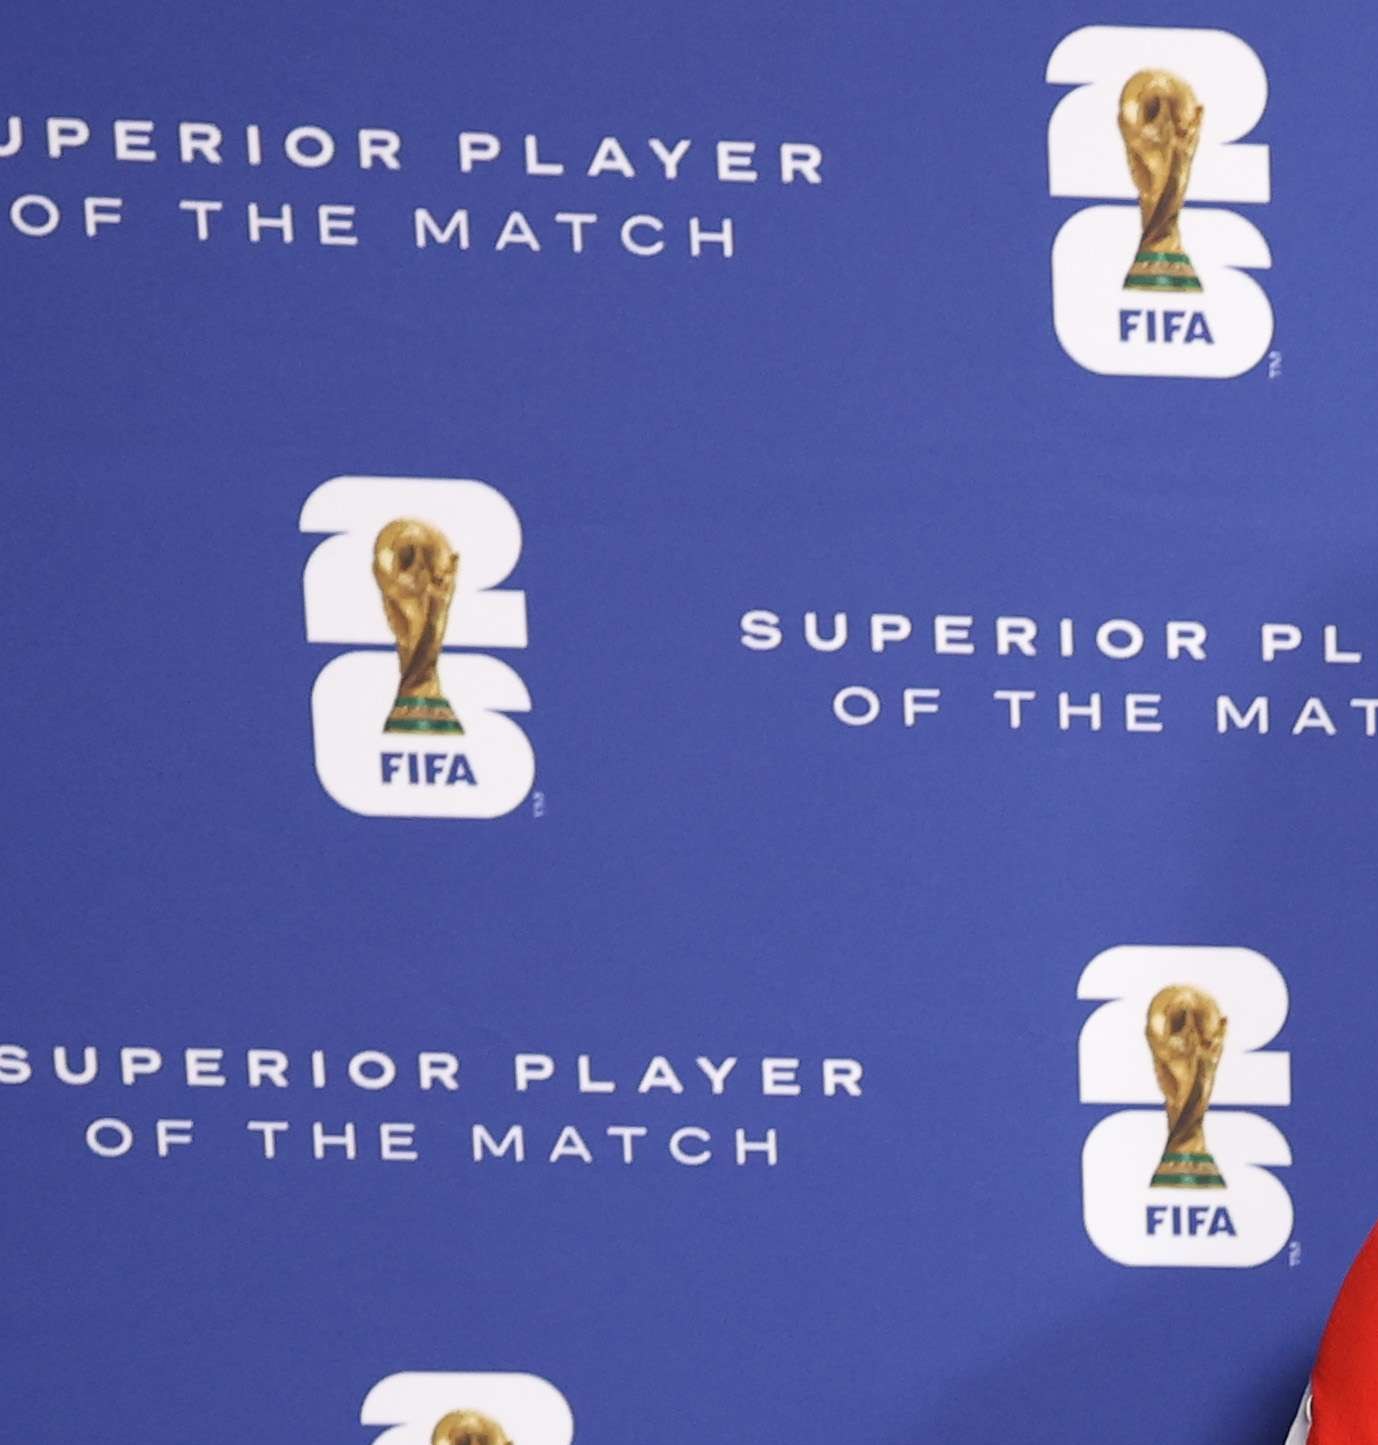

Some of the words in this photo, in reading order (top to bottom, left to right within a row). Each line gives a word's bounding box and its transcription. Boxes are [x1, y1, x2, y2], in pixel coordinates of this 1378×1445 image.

[0, 115, 401, 170] UPERIOR
[458, 131, 823, 184] PLAYER
[9, 194, 123, 238] OF
[178, 199, 359, 247] THE
[414, 207, 734, 258] MATCH
[1118, 308, 1215, 346] FIFA
[740, 609, 1207, 661] SUPERIOR
[832, 685, 941, 727] OF
[993, 689, 1164, 733] THE
[379, 751, 478, 787] FIFA
[0, 1044, 460, 1091] SUPERIOR
[514, 1053, 863, 1097] PLAYER
[85, 1117, 194, 1158] OF
[246, 1120, 419, 1162] THE
[472, 1123, 778, 1166] MATCH
[1145, 1204, 1238, 1238] FIFA
